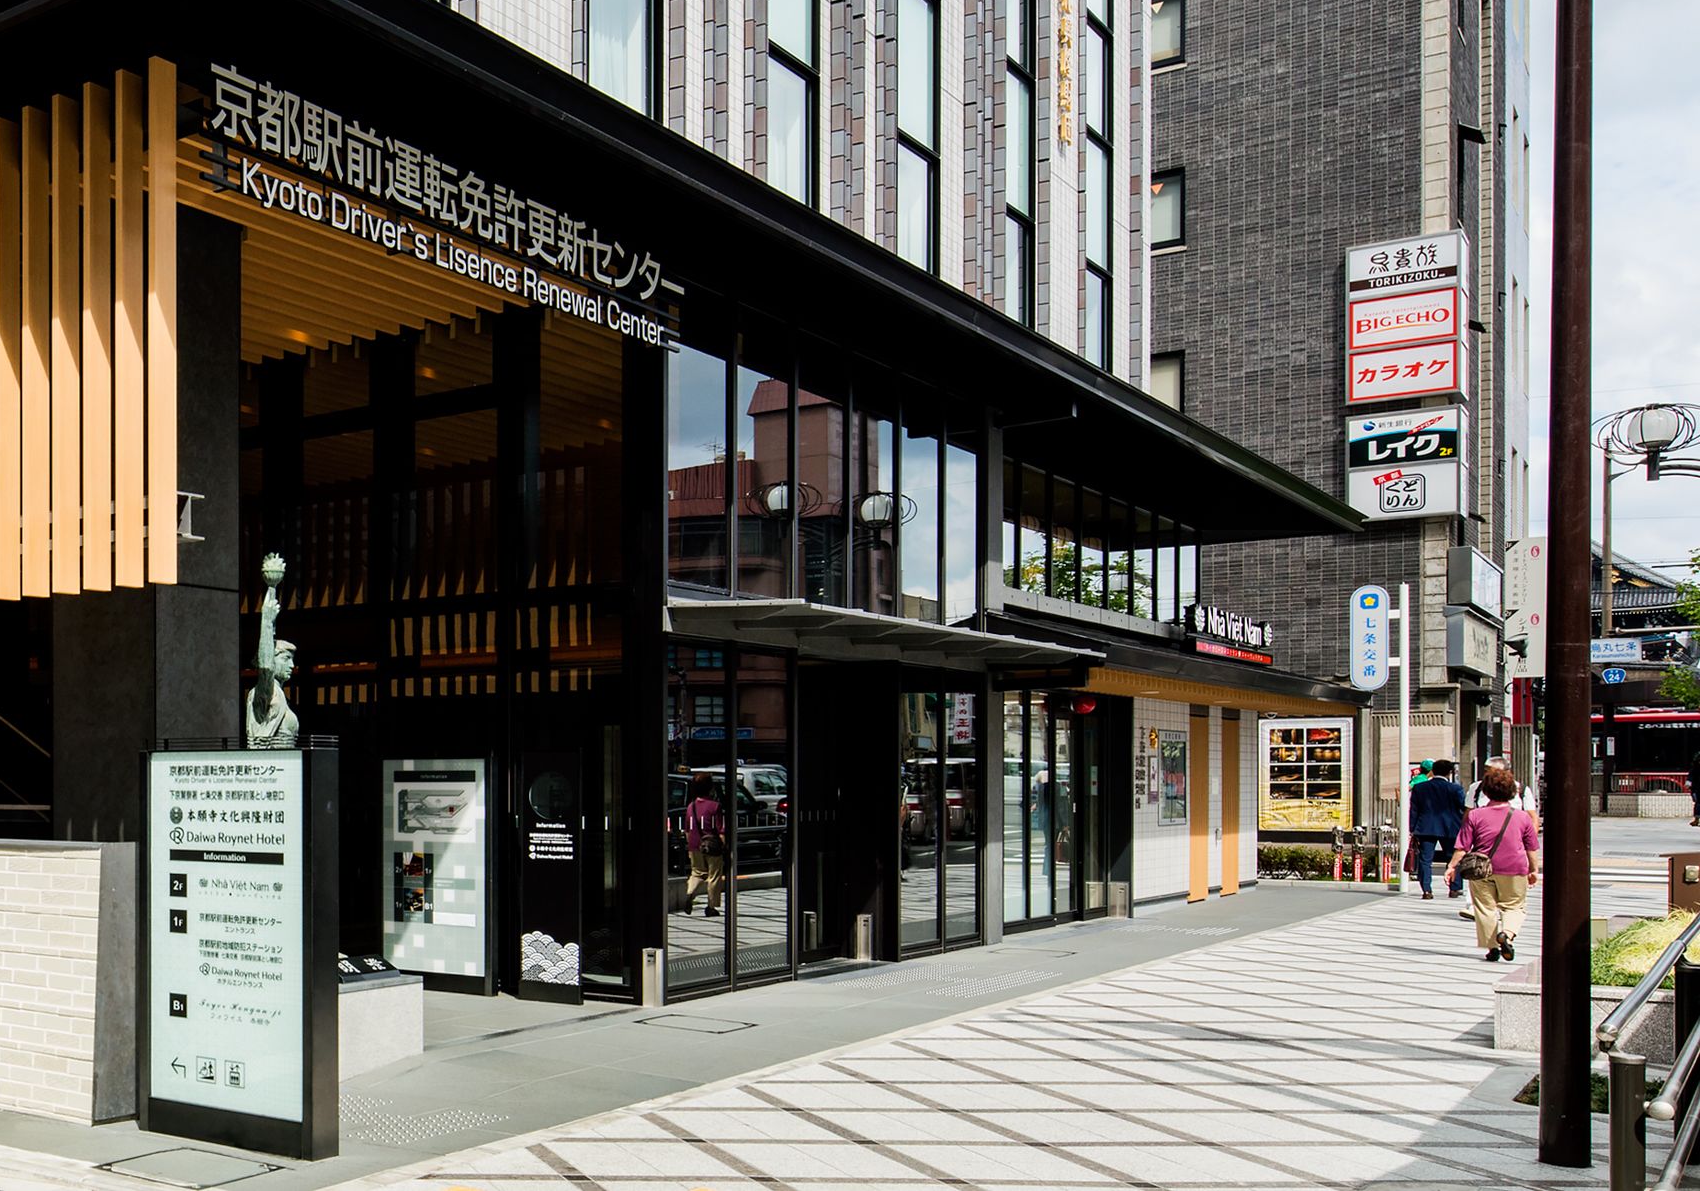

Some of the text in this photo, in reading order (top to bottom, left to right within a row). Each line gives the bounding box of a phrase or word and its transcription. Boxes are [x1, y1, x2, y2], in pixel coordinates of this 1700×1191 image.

[211, 63, 685, 300] 京都駅前運転免許更新センター
[242, 158, 324, 221] Kyoto
[435, 232, 518, 293] Lisence
[523, 267, 602, 324] Renewal
[607, 300, 664, 347] Center
[1368, 243, 1438, 274] 鳥貴族
[1368, 270, 1439, 288] TORIKIZOKU
[1356, 308, 1450, 334] BIG ECHO
[1356, 359, 1450, 384] カラオケ
[1368, 434, 1453, 461] レイク 2F
[1245, 617, 1262, 646] Nam
[1364, 618, 1376, 677] 七条交番
[169, 765, 284, 776] 京都駅前運転免許更新センター
[188, 810, 284, 824] 本願寺文化興隆財団
[187, 831, 216, 843] Daiwa
[218, 832, 253, 846] Roynet
[256, 833, 284, 845] Hotel
[204, 852, 246, 861] Information
[173, 880, 183, 890] 2F
[250, 882, 269, 891] Nam
[173, 916, 183, 926] 1F
[212, 966, 233, 976] Daiwa
[234, 968, 260, 979] Roynet
[262, 971, 282, 981] Hotel
[173, 1000, 183, 1010] B1
